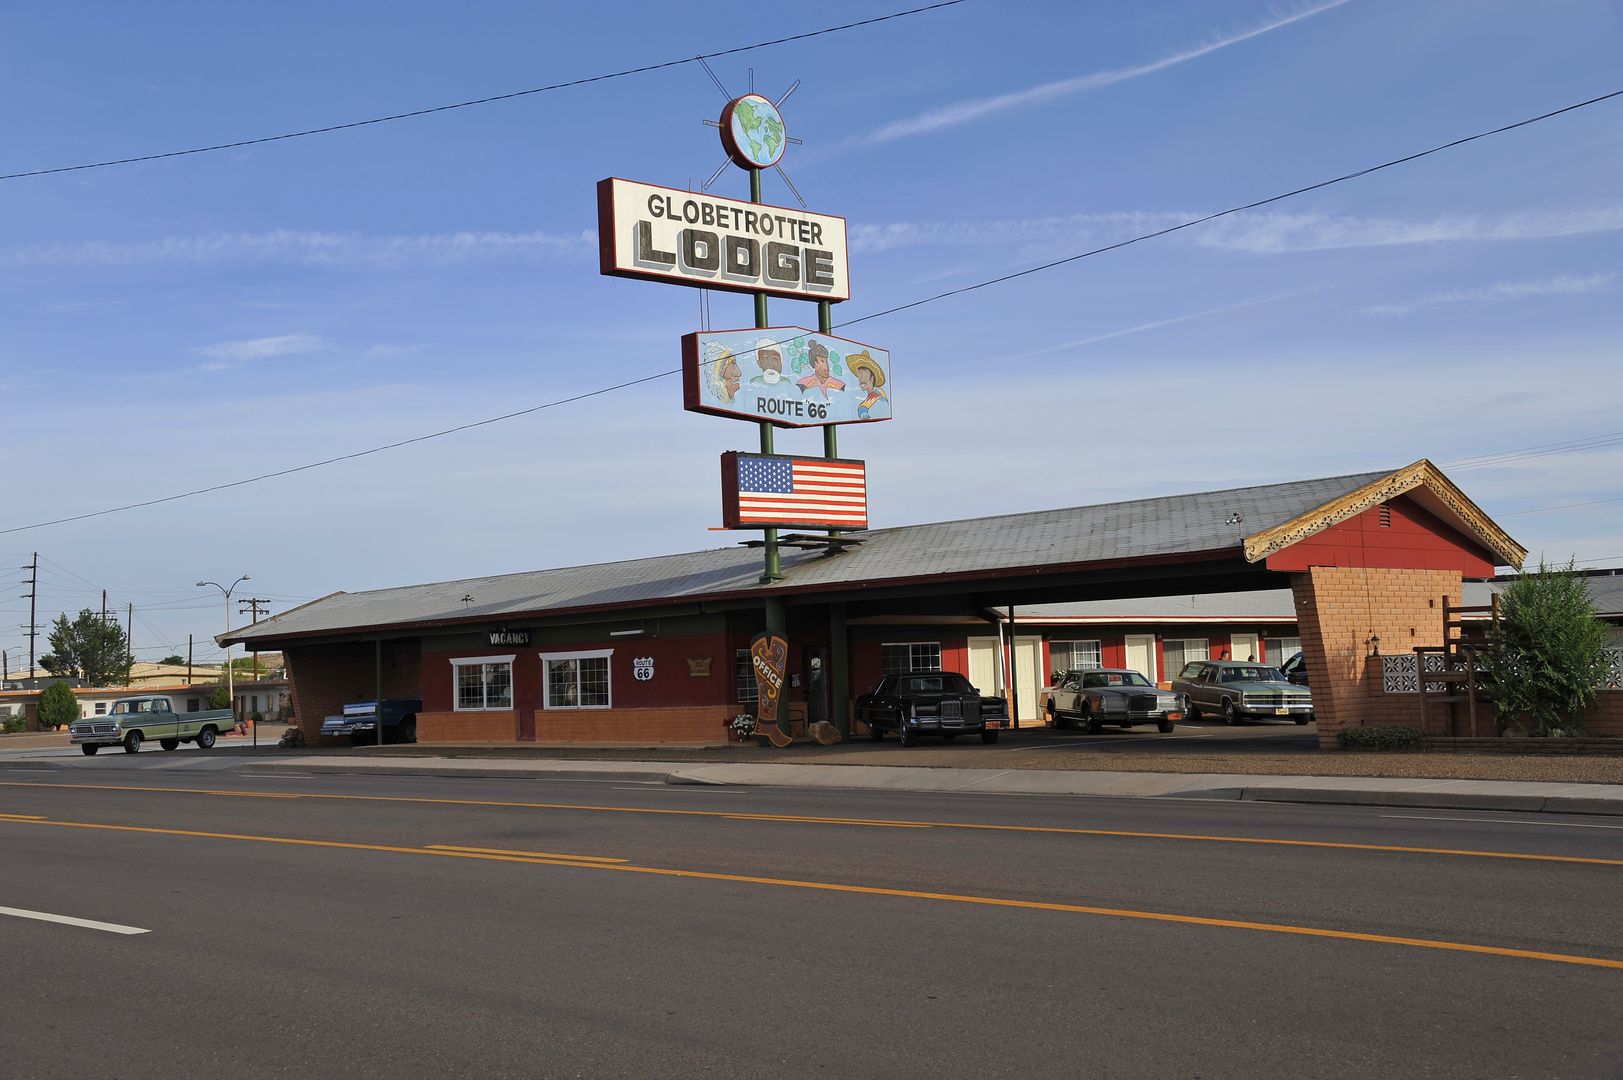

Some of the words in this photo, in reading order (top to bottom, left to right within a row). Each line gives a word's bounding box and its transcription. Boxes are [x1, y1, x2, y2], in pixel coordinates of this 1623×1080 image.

[648, 194, 823, 246] GLOBETROTTER
[633, 219, 835, 293] LODGE
[757, 396, 804, 417] ROUTE
[489, 632, 529, 645] VACANCY
[635, 659, 652, 667] ROUTE
[636, 668, 650, 679] 66
[752, 655, 783, 689] OFFICE
